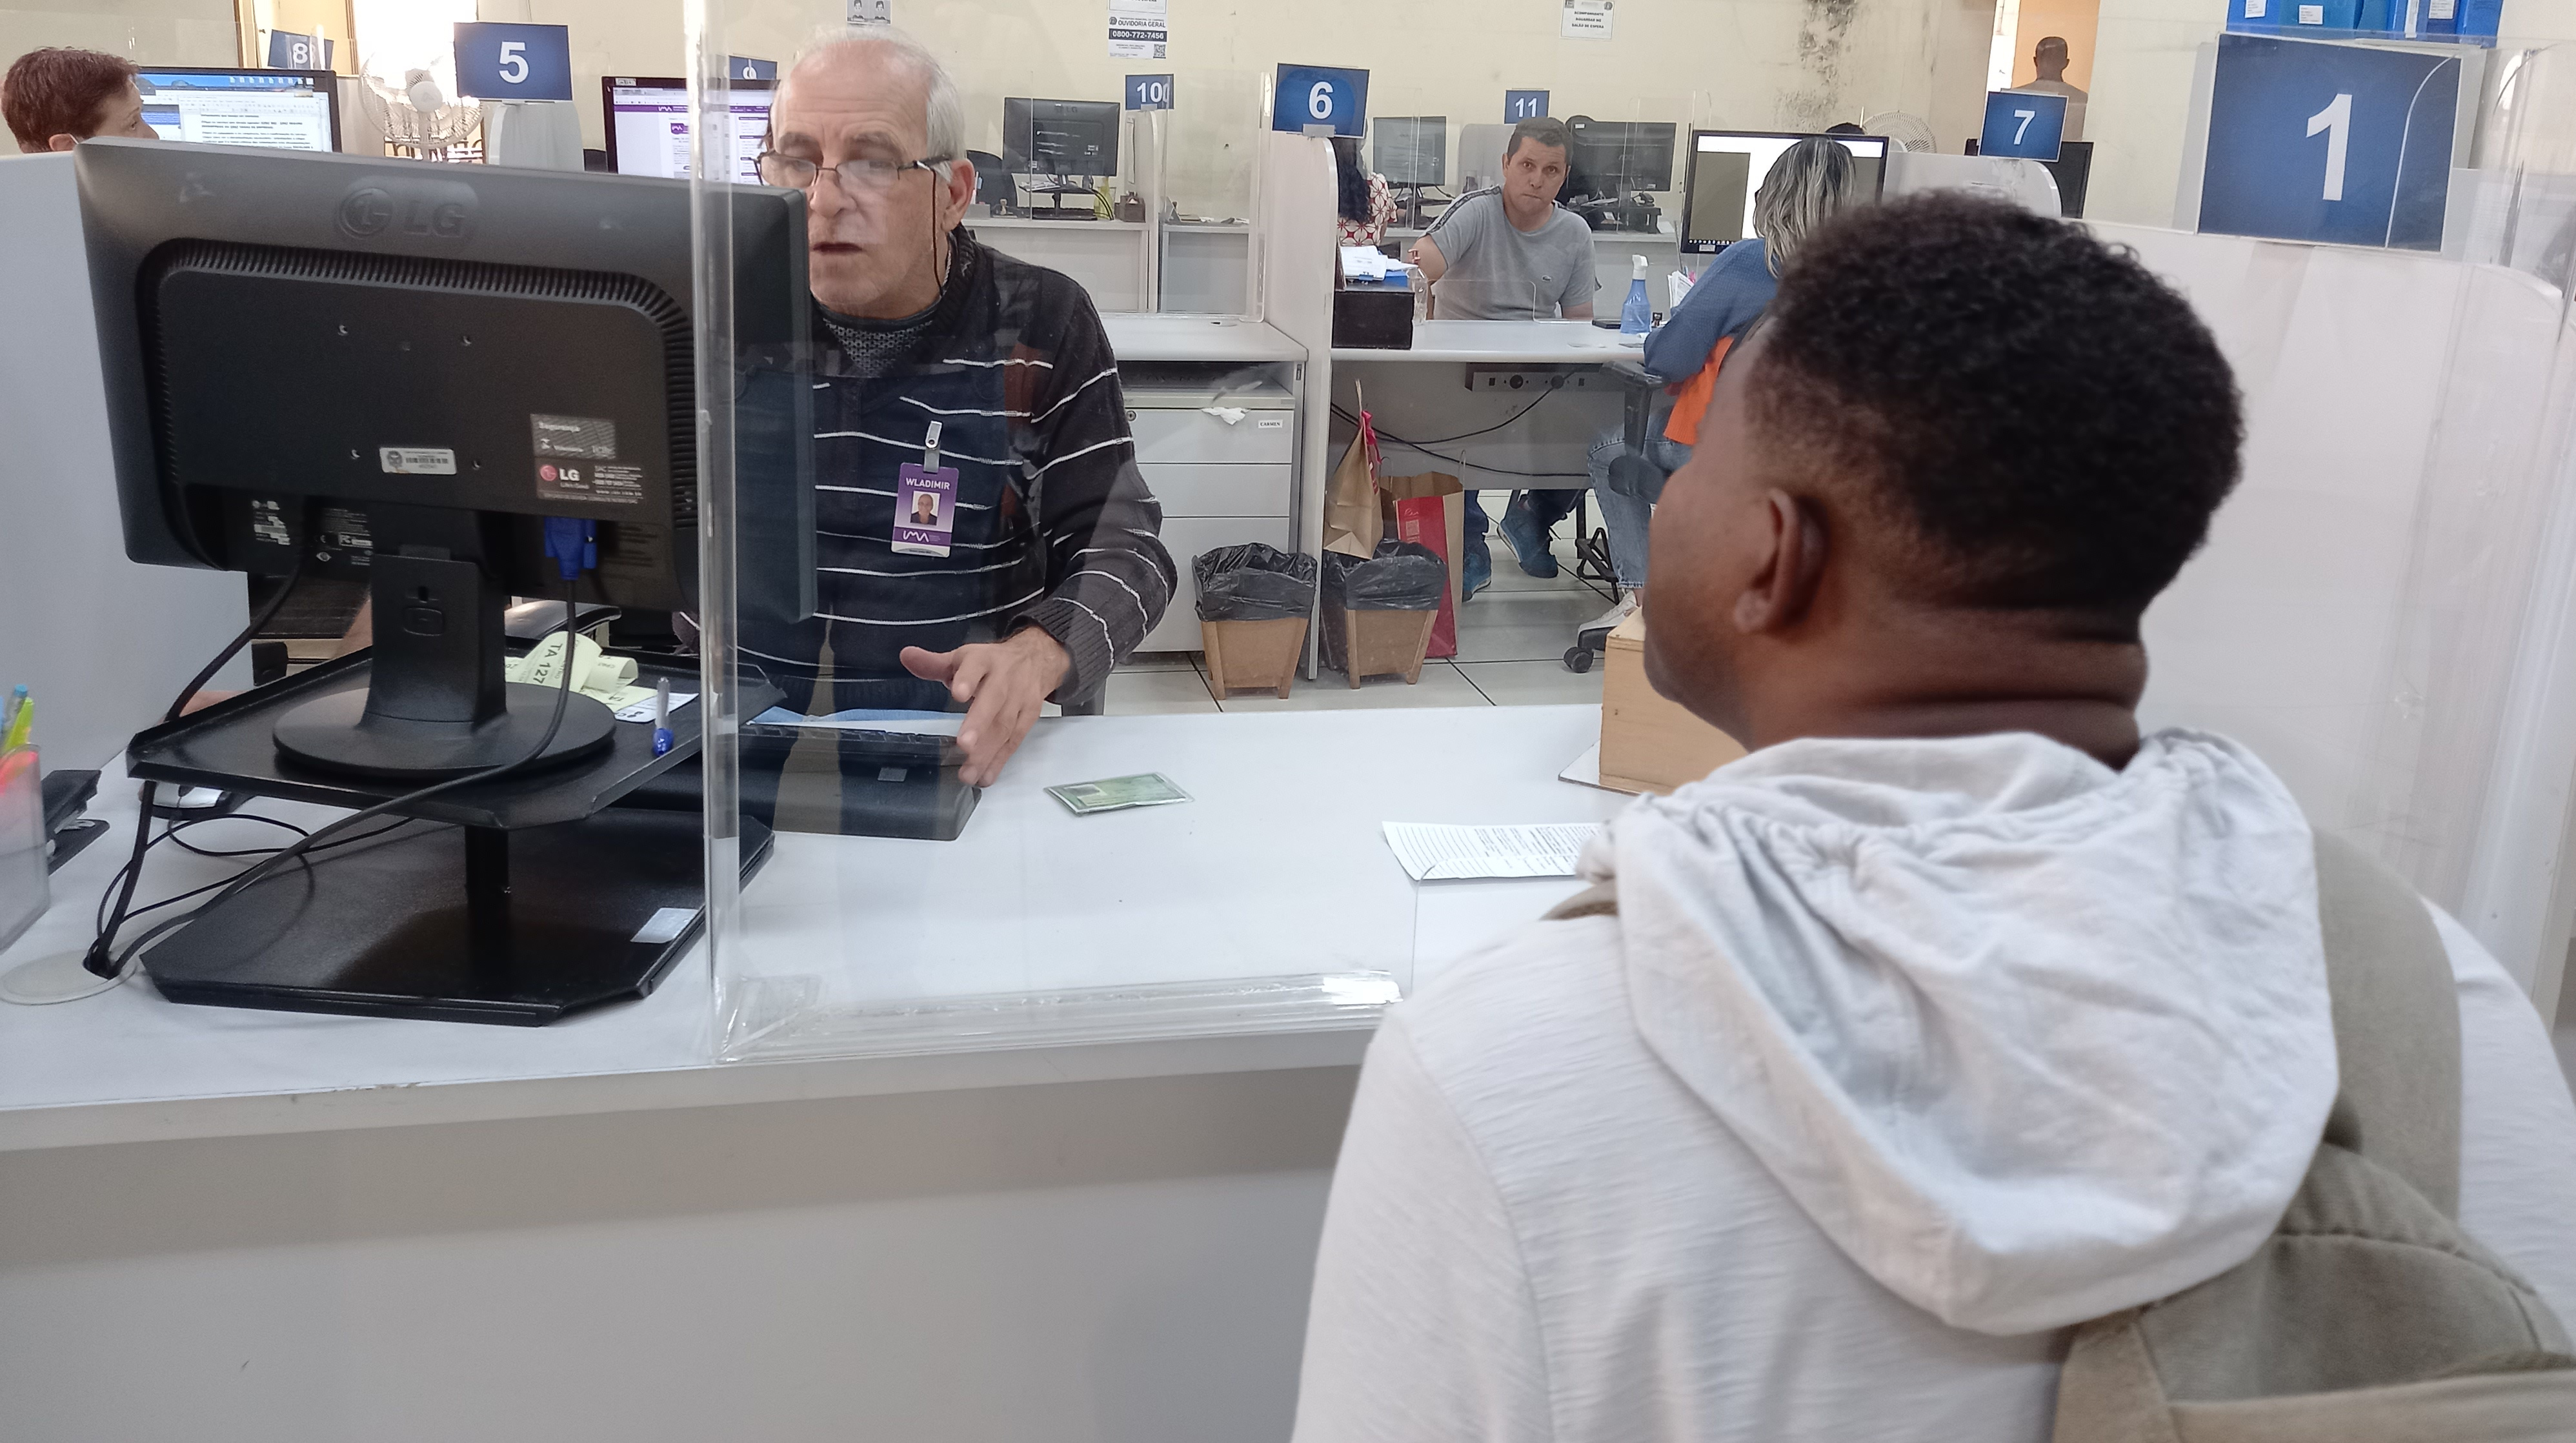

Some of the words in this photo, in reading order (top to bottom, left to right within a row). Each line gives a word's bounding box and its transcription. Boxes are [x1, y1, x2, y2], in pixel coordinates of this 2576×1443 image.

[293, 43, 308, 64] 8
[499, 42, 530, 85] 5
[1136, 82, 1163, 103] 10
[1308, 81, 1334, 119] 6
[1516, 97, 1536, 117] 11
[2013, 110, 2036, 145] 7
[2306, 94, 2352, 200] 1
[558, 468, 580, 481] LG
[905, 477, 951, 490] WLADIMIR
[544, 643, 563, 659] TA
[532, 662, 552, 684] 127
